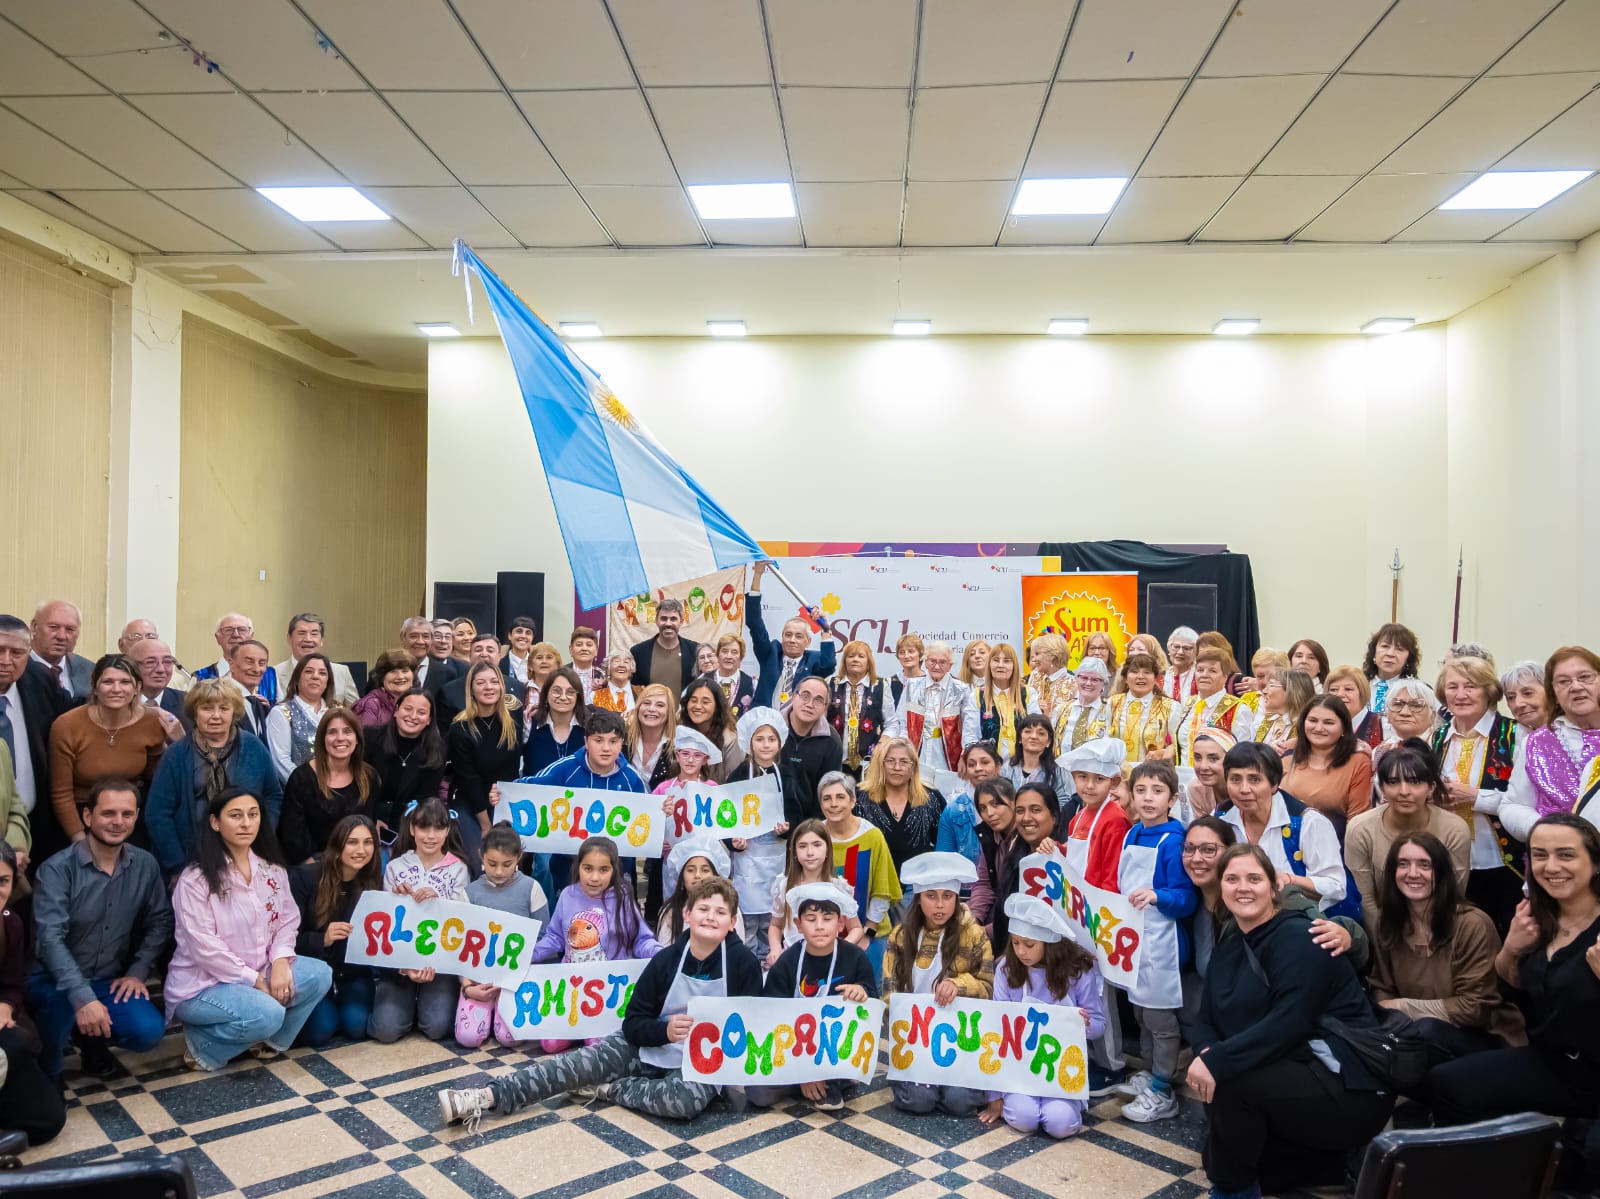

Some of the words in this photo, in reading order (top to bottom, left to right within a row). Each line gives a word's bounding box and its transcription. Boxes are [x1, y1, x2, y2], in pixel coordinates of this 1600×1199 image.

[962, 631, 1009, 641] Comercio
[1055, 607, 1108, 643] Sum
[508, 789, 651, 847] DIÁLOGO
[674, 793, 761, 838] AMOR
[689, 1004, 875, 1076] COMPAÑÍA
[890, 1003, 1085, 1093] ENCUENTRO
